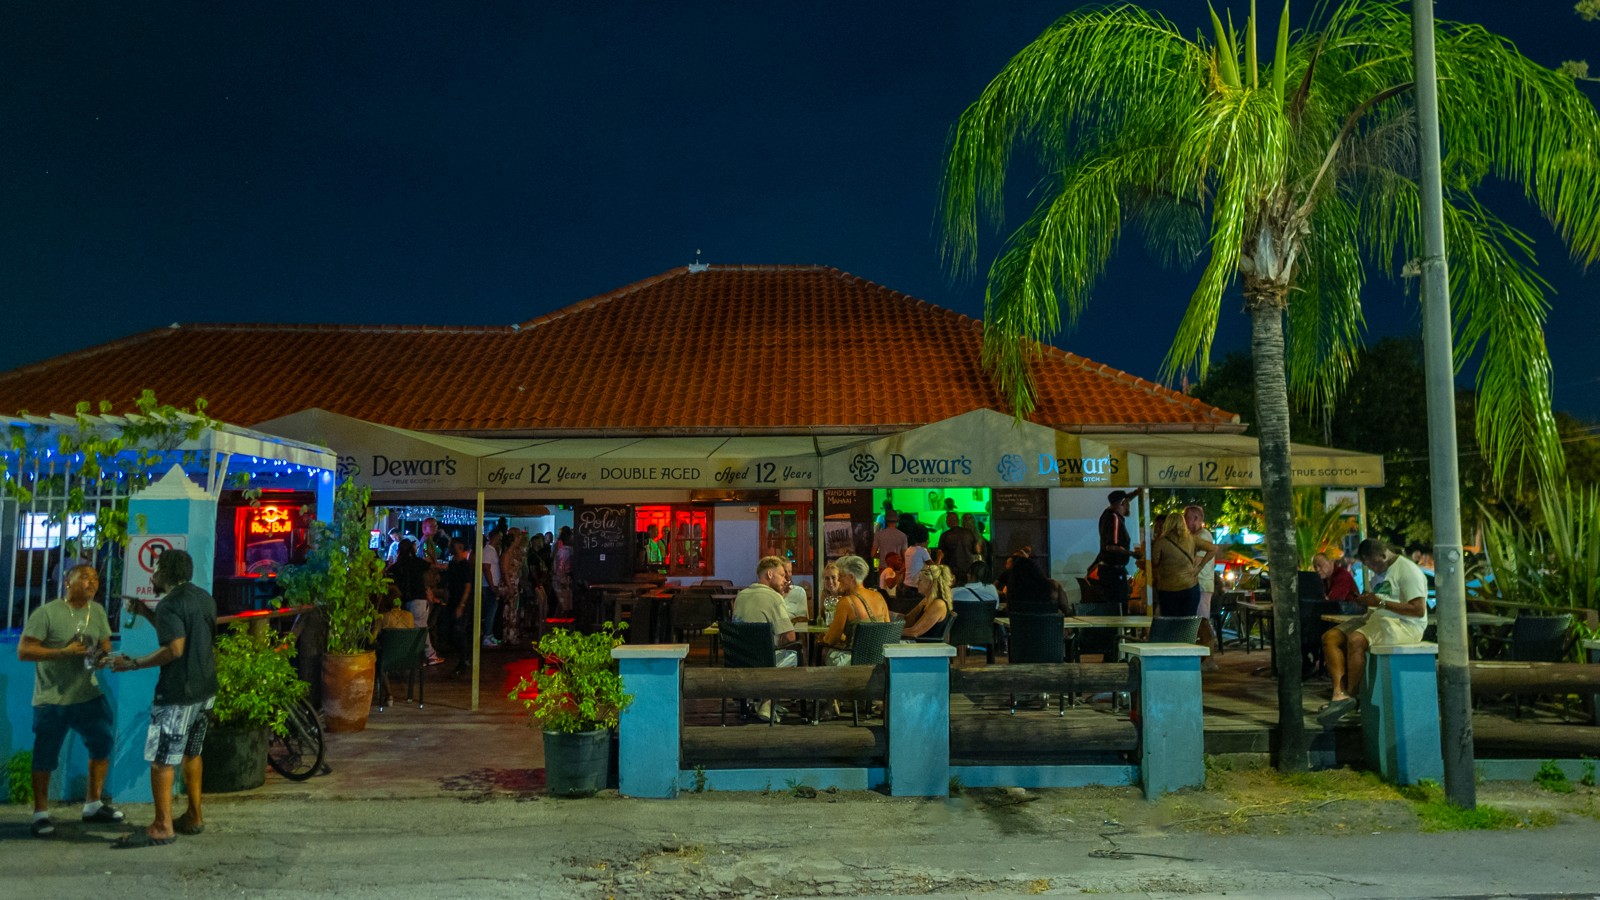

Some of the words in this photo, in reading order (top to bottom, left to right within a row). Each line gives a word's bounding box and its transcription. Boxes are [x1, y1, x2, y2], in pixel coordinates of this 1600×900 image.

[372, 455, 457, 476] Dewar's
[488, 467, 524, 484] Aged
[529, 463, 551, 484] 12
[557, 467, 587, 482] Years
[600, 467, 657, 480] DOUBLE
[661, 467, 701, 480] AGED
[714, 466, 750, 484] Aged
[755, 462, 777, 483] 12
[783, 466, 812, 481] Years
[890, 453, 972, 475] Dewar's
[1038, 453, 1119, 475] Dewar's
[1158, 465, 1193, 482] Aged
[1198, 461, 1218, 482] 12
[1225, 465, 1253, 480] Years
[1318, 468, 1357, 476] SCOTCH
[251, 521, 271, 533] Red
[272, 521, 292, 533] Bull
